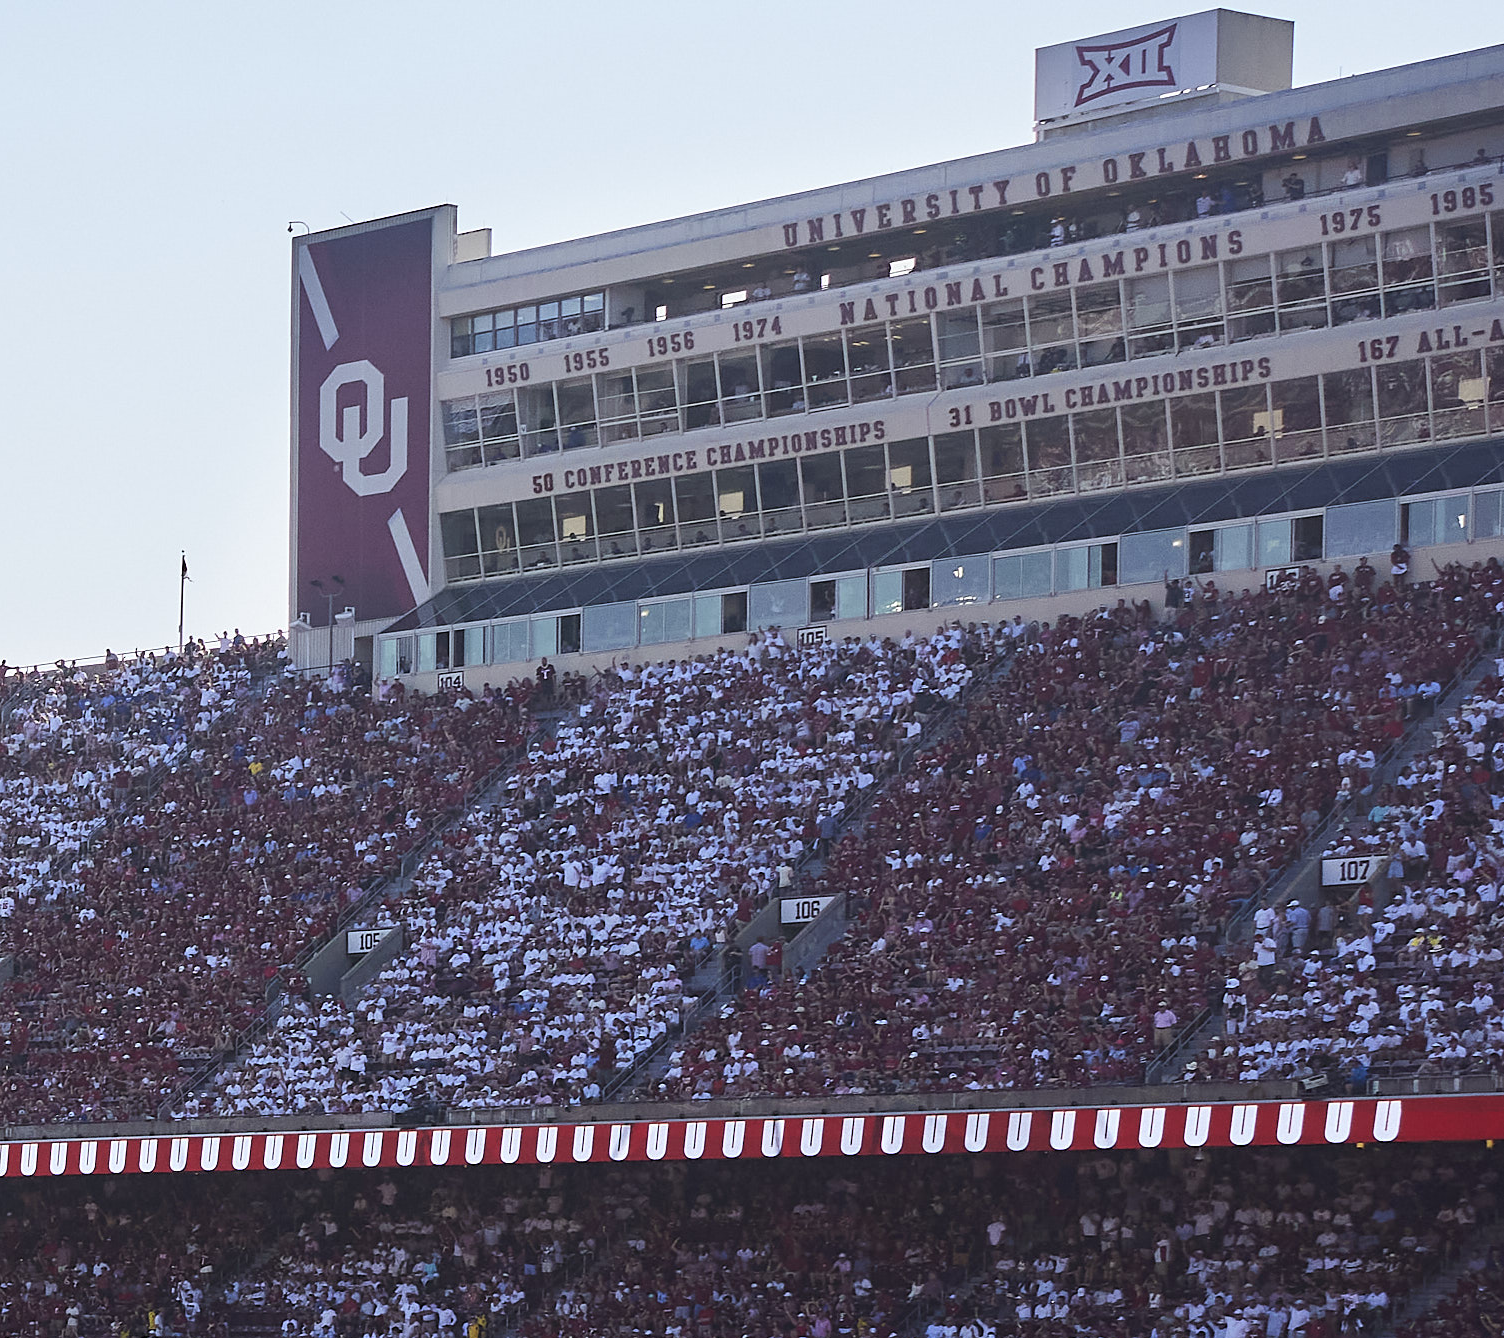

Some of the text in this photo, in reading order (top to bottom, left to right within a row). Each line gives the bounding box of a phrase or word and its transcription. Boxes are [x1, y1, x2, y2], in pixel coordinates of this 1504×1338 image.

[784, 116, 1325, 247] UNIVERSITY OF OKLAHOMA
[1431, 184, 1494, 215] 1985
[1320, 205, 1381, 236] 1975
[839, 230, 1243, 326] NATIONAL CHAMPIONS
[733, 315, 782, 341] 1974
[646, 331, 695, 357] 1956
[1357, 335, 1399, 362] 167
[564, 347, 610, 372] 1955
[486, 363, 531, 387] 1950
[949, 358, 1272, 428] 31 BOWL CHAMPIONSHIPS
[319, 359, 408, 496] OU
[533, 420, 886, 493] 50 CONFERENCE CHAMPIONSHIPS
[1340, 860, 1368, 881] 107
[795, 899, 820, 919] 106
[360, 933, 380, 949] 105
